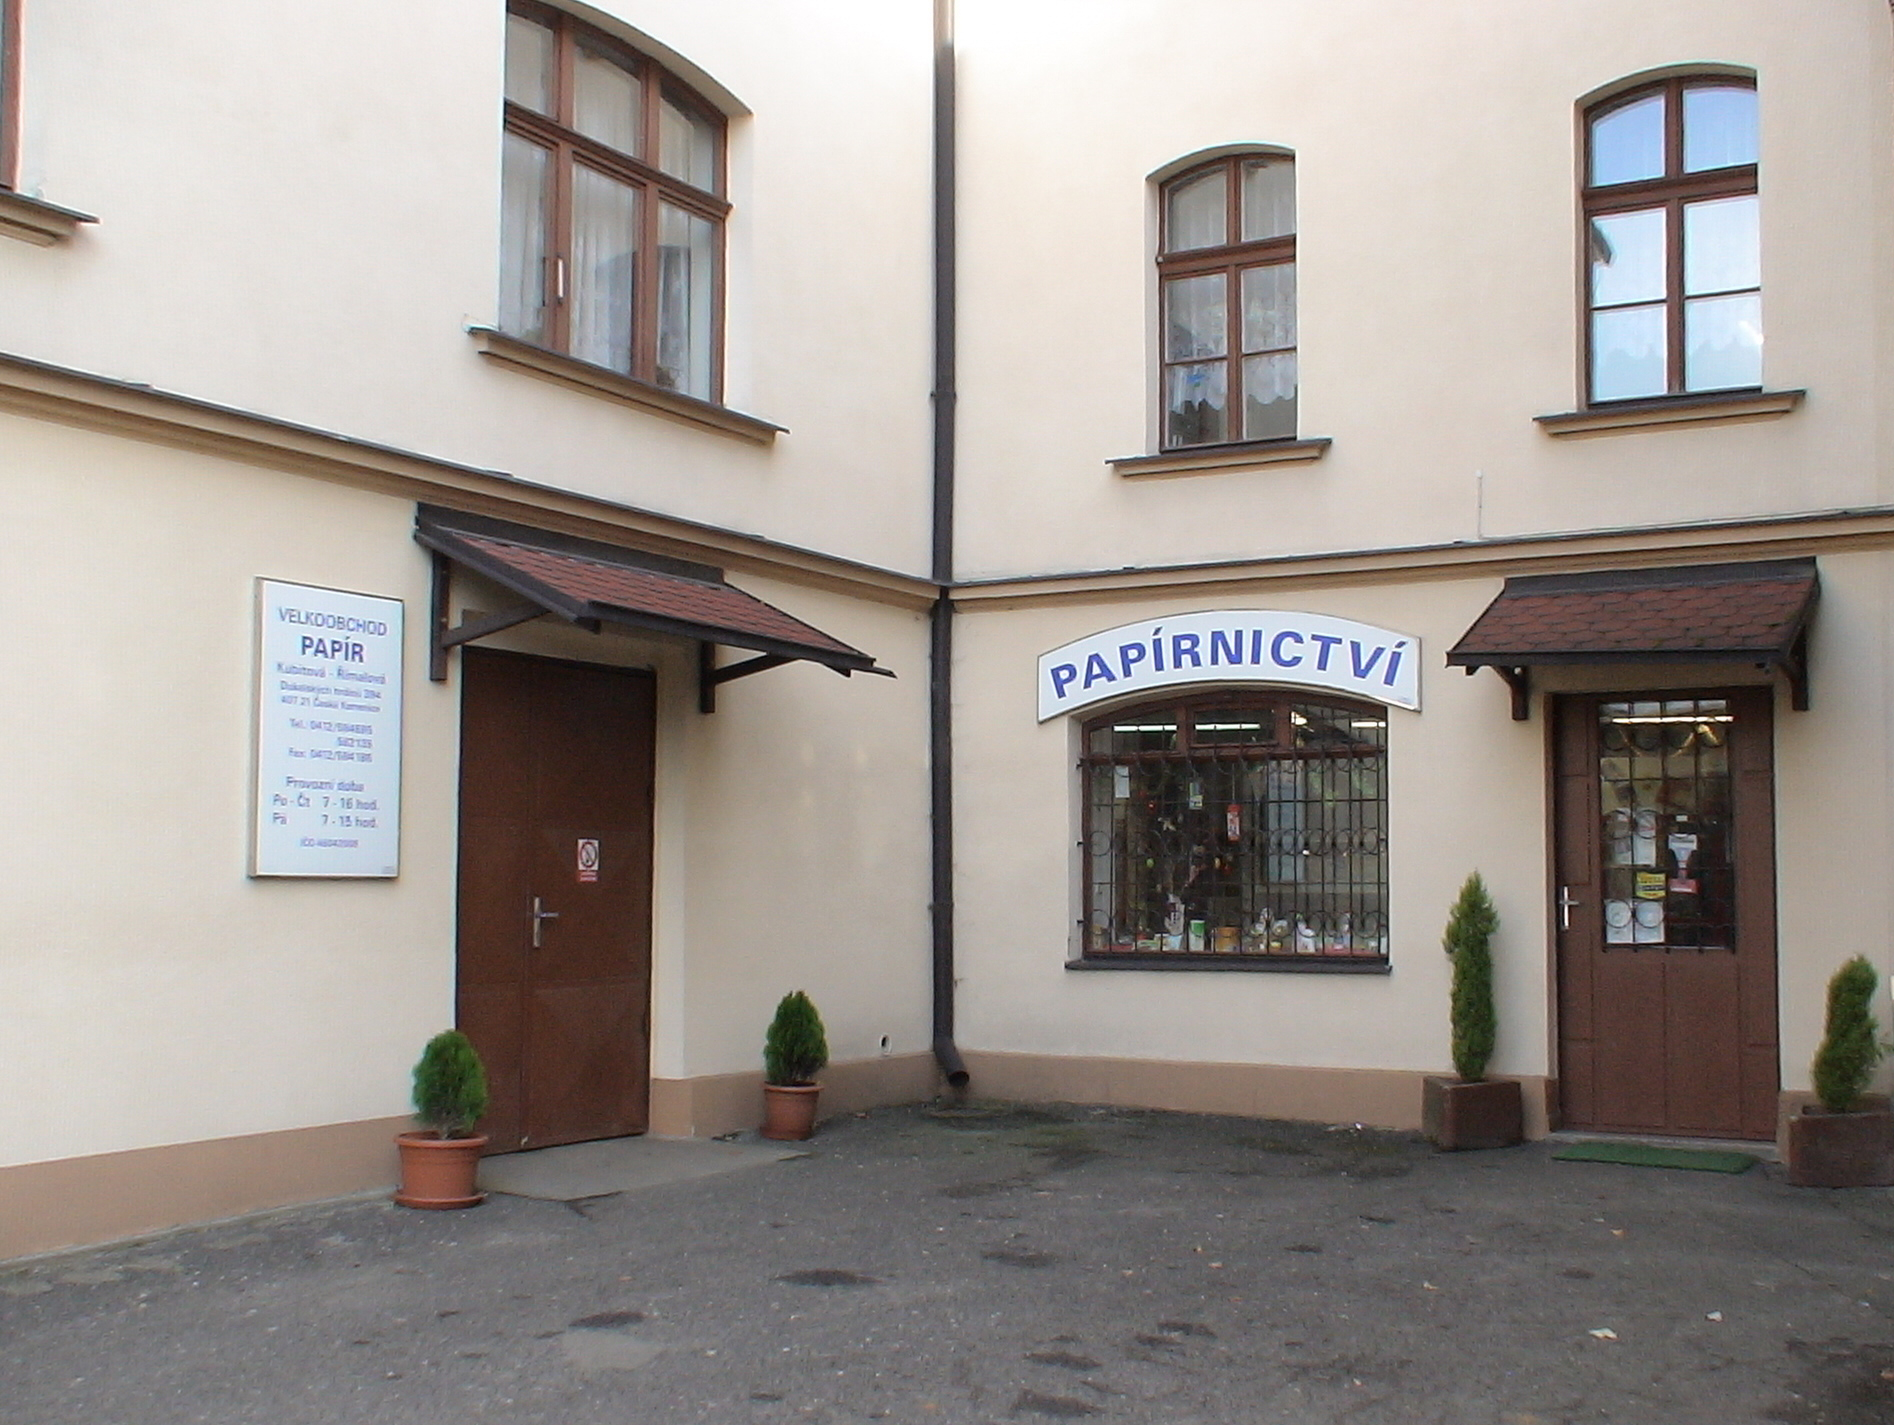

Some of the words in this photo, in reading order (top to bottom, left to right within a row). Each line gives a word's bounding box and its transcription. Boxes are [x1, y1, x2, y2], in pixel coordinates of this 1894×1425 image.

[279, 607, 388, 636] VELKOOBCHOD
[301, 635, 364, 663] PAPÍR
[1049, 625, 1409, 699] PAPÍRNICTVÍ
[286, 776, 334, 790] Provozní
[273, 793, 287, 806] Po
[322, 796, 330, 808] 7
[322, 814, 329, 826] 7
